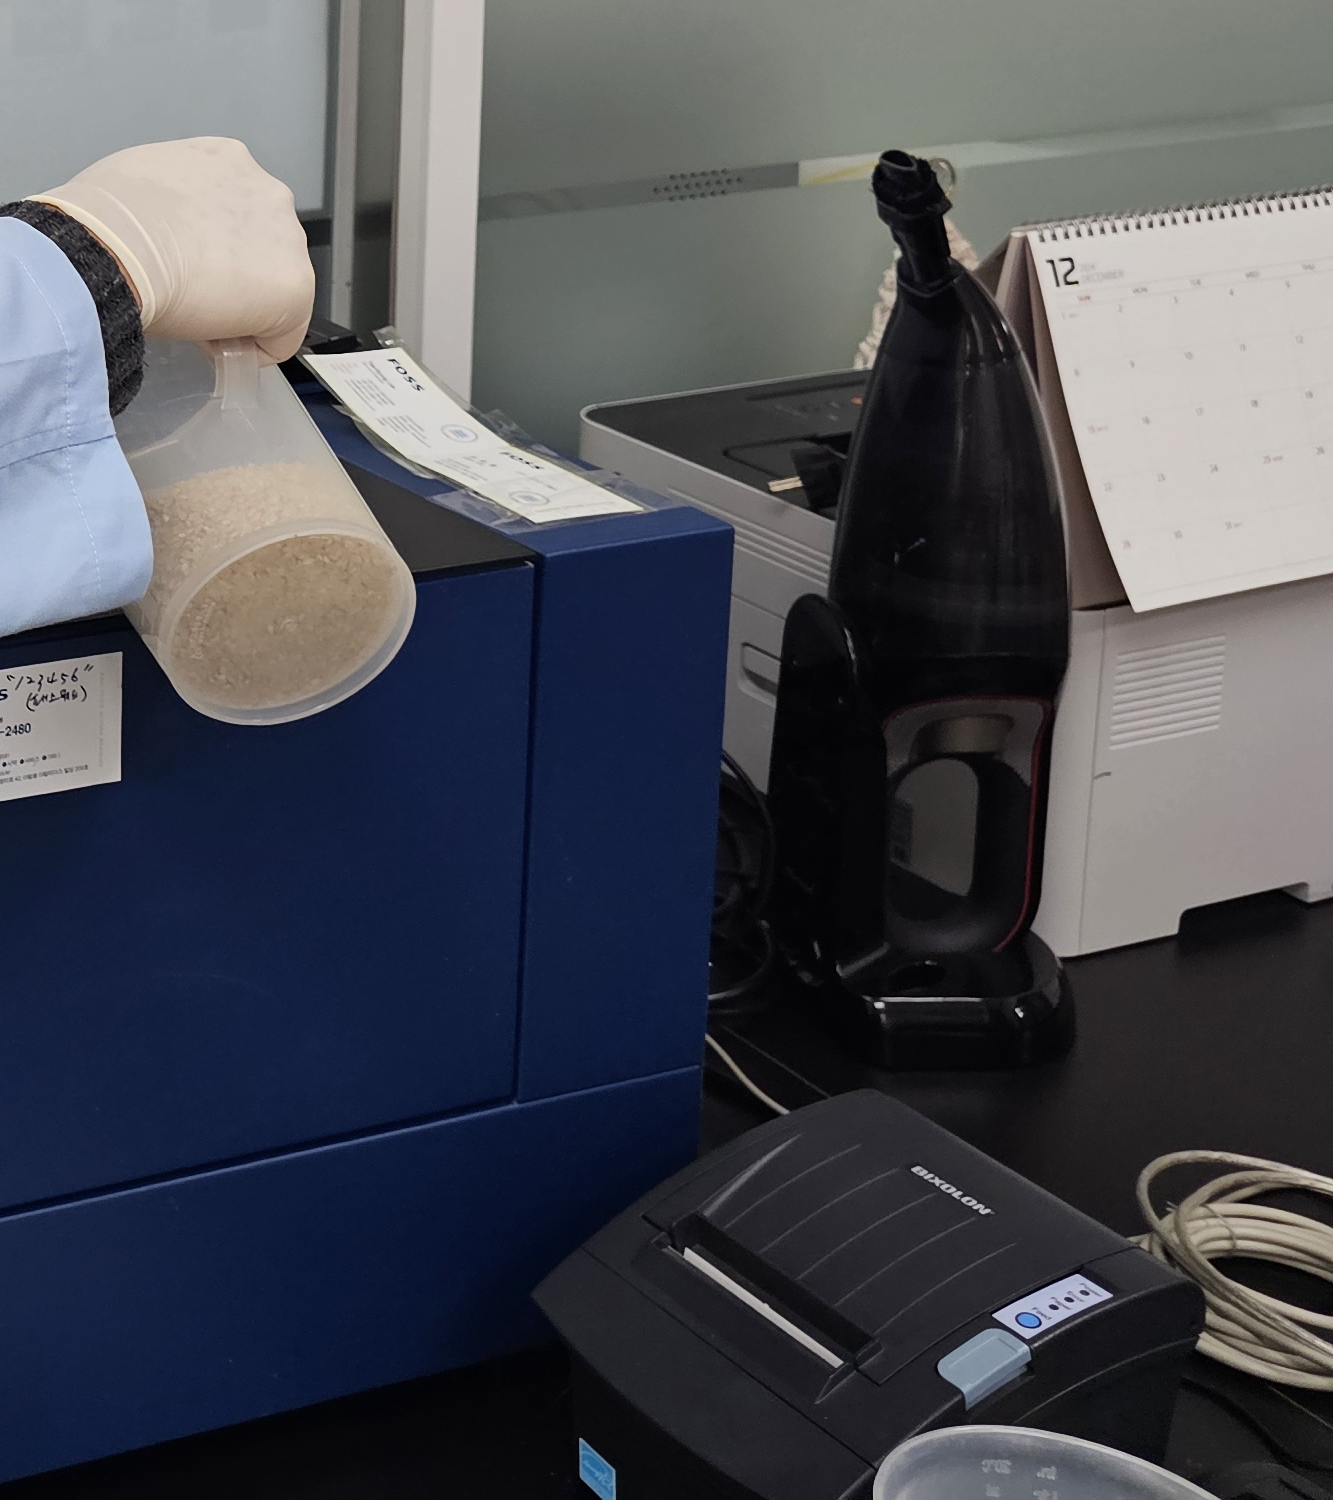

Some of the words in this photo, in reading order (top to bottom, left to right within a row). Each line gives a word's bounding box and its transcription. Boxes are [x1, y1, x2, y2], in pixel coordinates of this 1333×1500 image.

[1045, 257, 1079, 288] 12
[387, 358, 425, 392] FOSS
[911, 1166, 992, 1214] BIXOLON
[1031, 1307, 1051, 1320] Feed
